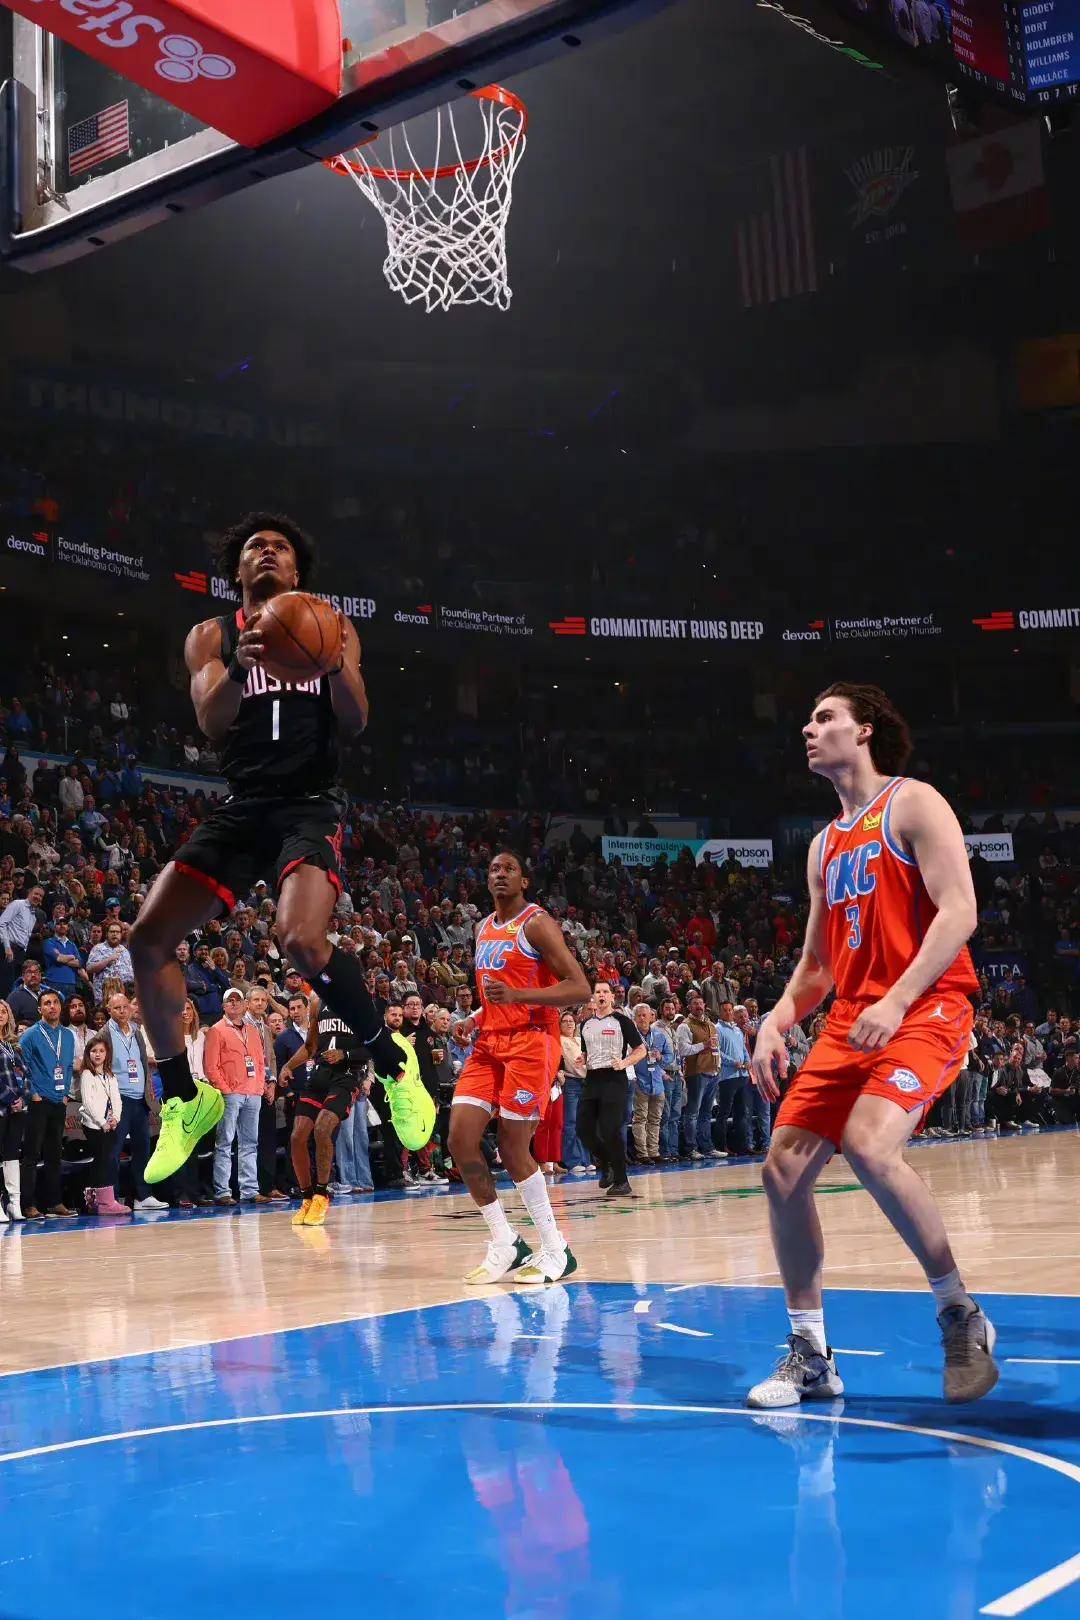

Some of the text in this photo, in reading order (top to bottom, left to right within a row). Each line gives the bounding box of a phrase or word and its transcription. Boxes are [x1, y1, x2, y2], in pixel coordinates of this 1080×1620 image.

[1023, 1, 1054, 18] GIDDEY
[1024, 20, 1048, 34] DORT
[1026, 31, 1074, 51] HOLMGREN
[1028, 50, 1070, 68] WILLIAMS
[1030, 68, 1069, 86] WALLACE
[1037, 91, 1050, 102] TO
[7, 534, 45, 556] devon
[58, 536, 144, 567] Founding Partner of
[58, 550, 150, 581] the Oklahoma City Thunder
[343, 596, 377, 619] DEEP
[441, 606, 525, 625] Founding Partner of
[394, 610, 430, 625] devon
[834, 613, 934, 629] Founding Partner of
[441, 619, 534, 635] the Oklahoma City Thunder
[590, 617, 764, 640] COMMITMENT RUNS DEEP
[782, 629, 821, 641] devon
[834, 625, 942, 640] the Oklahoma City Thunder
[272, 699, 280, 741] 1
[608, 840, 643, 850] Internet
[622, 853, 641, 863] This
[642, 854, 657, 863] Fas
[826, 840, 882, 910] OKC
[845, 904, 862, 951] 3
[328, 1036, 337, 1051] 4
